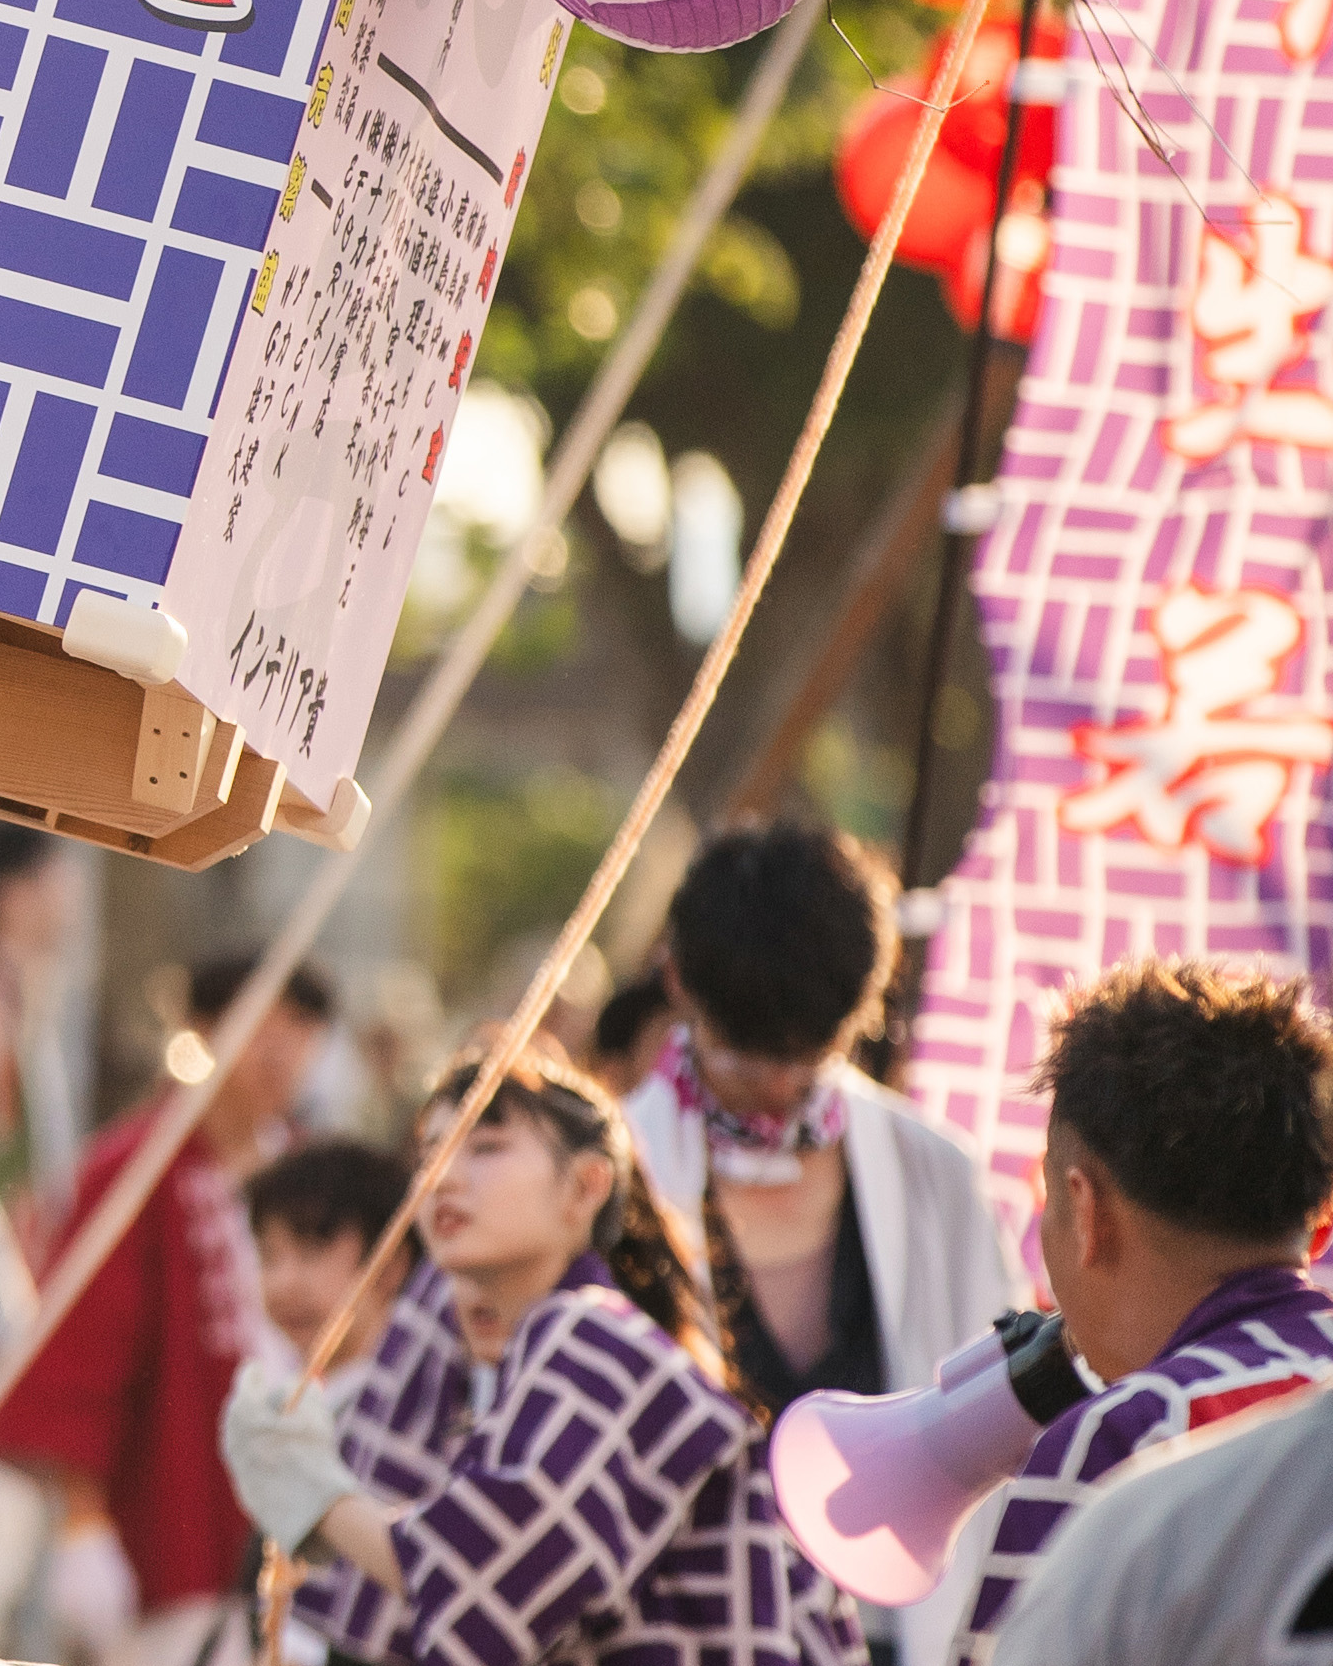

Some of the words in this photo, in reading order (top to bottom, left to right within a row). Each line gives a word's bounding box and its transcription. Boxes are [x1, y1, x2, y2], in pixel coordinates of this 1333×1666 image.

[229, 608, 328, 759] インテリア貴
